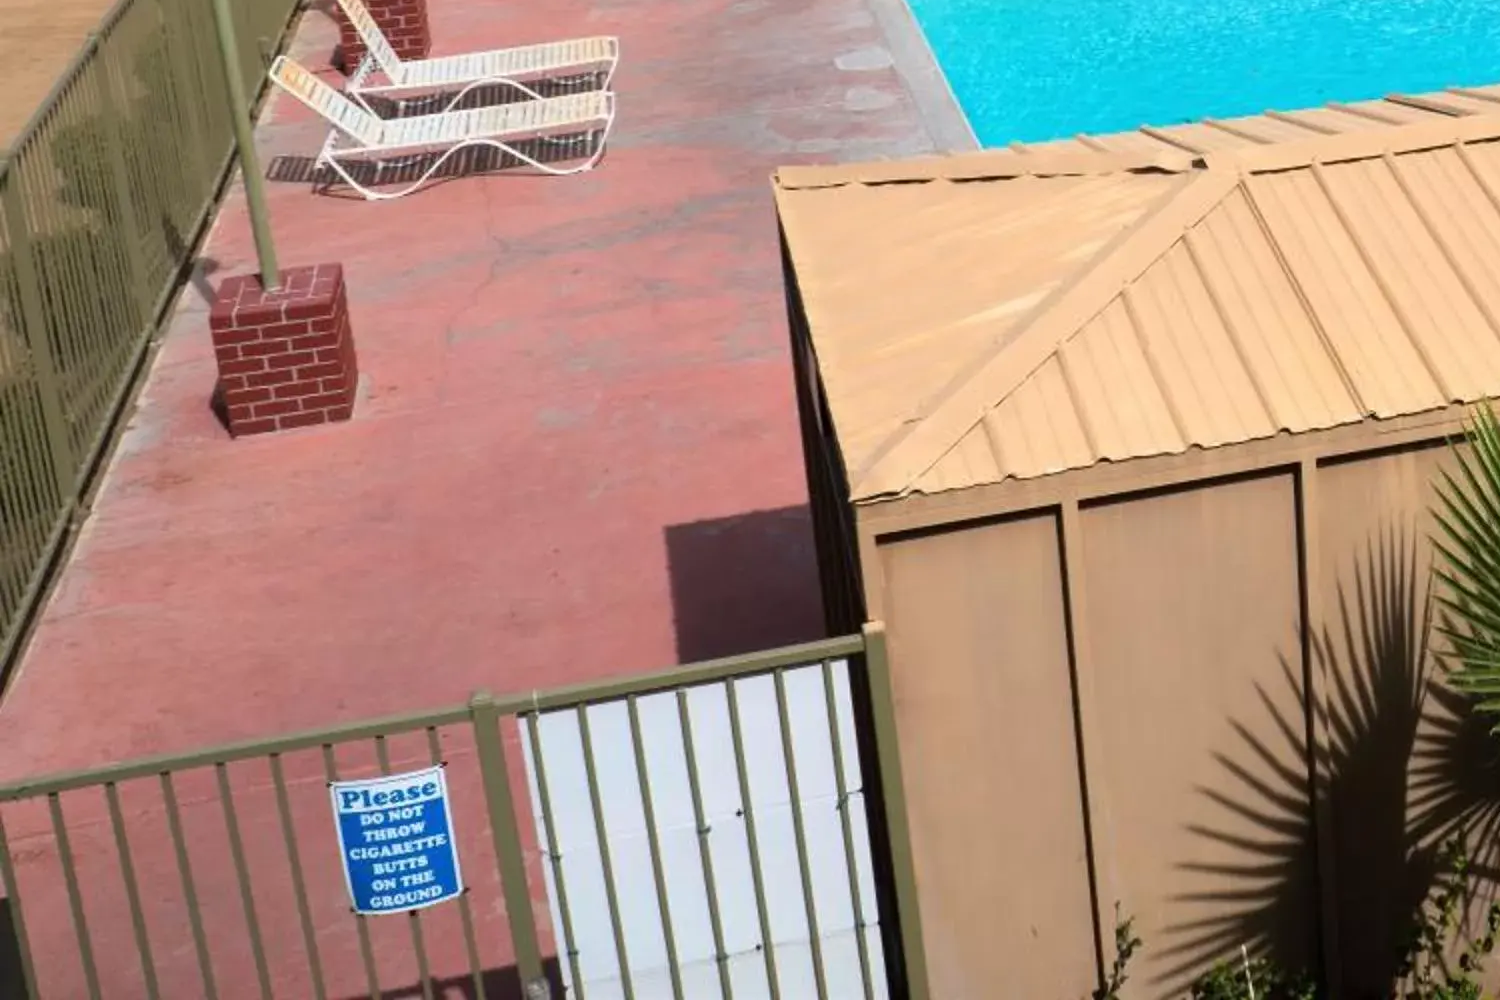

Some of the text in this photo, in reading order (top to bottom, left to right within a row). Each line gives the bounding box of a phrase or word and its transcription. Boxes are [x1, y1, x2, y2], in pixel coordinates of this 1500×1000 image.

[341, 782, 436, 809] Please
[361, 804, 425, 826] DO NOT
[362, 821, 426, 842] THROW
[349, 833, 448, 860] CIGARETTE
[372, 855, 429, 875] BUTTS
[371, 870, 436, 892] ON THE
[370, 885, 443, 908] GROUND
